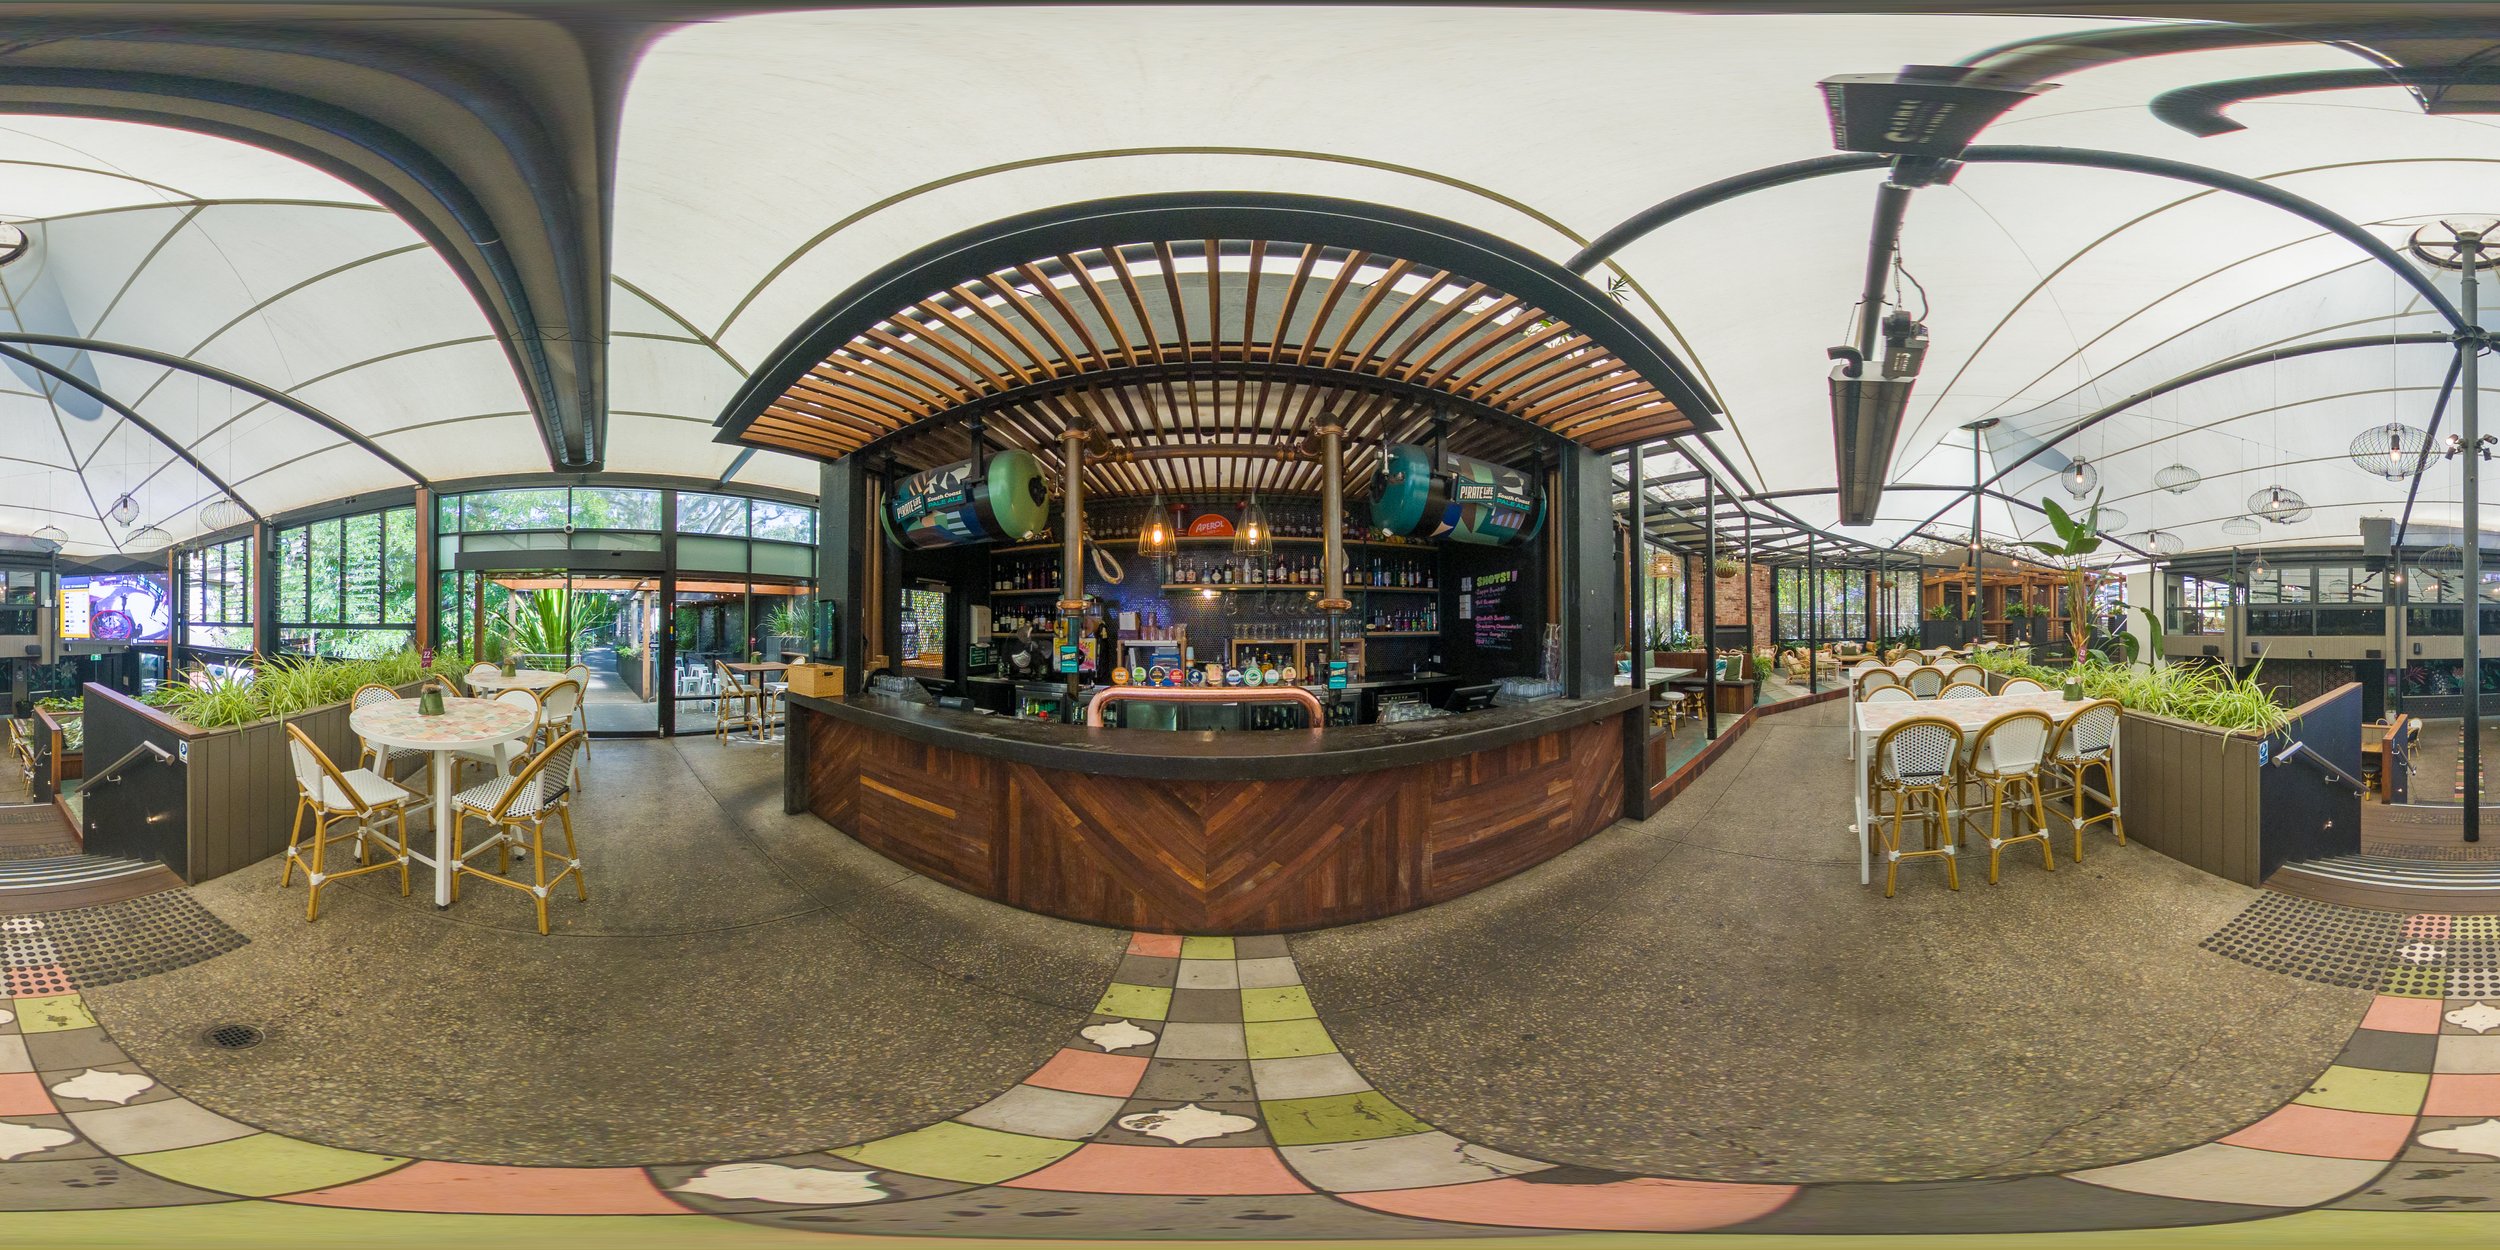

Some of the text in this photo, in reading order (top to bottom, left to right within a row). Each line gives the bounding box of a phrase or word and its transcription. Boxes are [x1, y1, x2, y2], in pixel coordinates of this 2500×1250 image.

[927, 494, 944, 502] South
[927, 499, 947, 508] PALE
[947, 495, 963, 503] ALE
[1497, 492, 1514, 501] South
[1497, 498, 1515, 507] PALE
[1195, 520, 1224, 533] APEROL
[1477, 571, 1511, 586] SHOTS!
